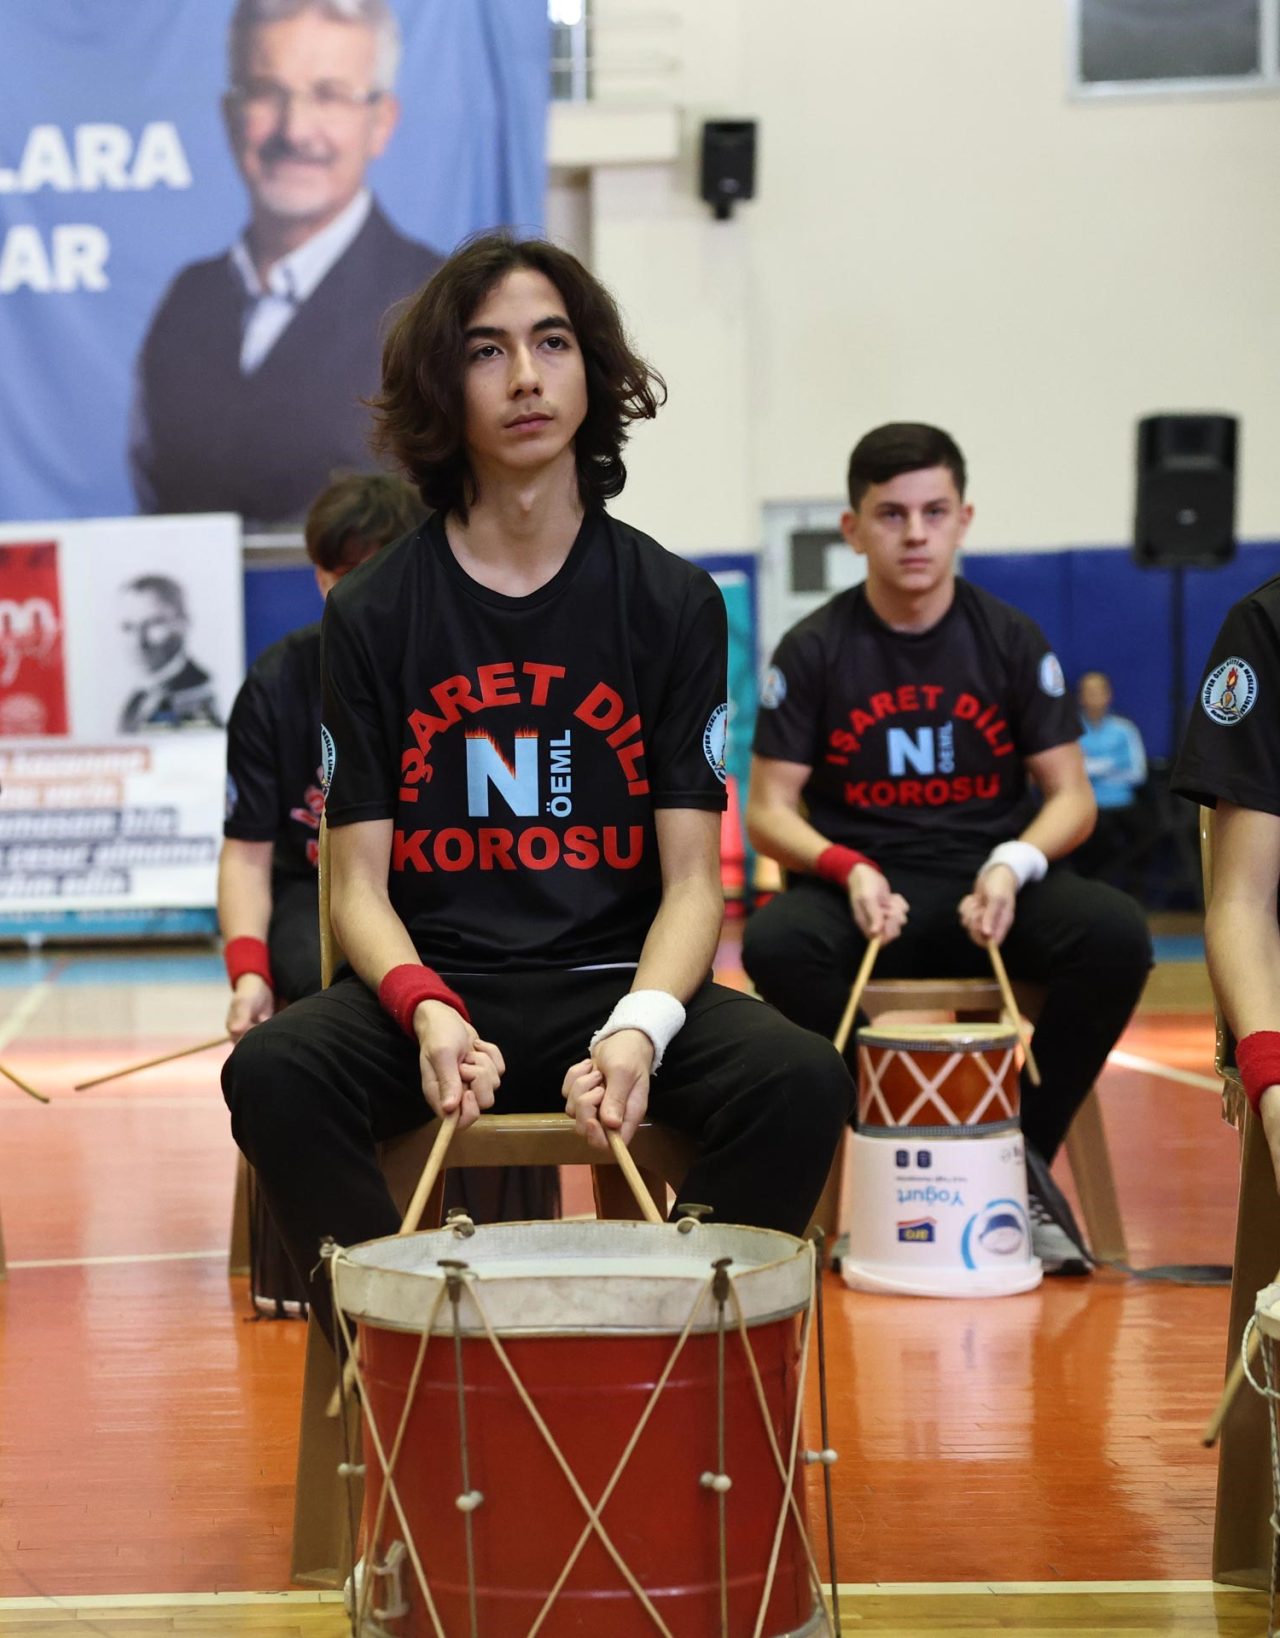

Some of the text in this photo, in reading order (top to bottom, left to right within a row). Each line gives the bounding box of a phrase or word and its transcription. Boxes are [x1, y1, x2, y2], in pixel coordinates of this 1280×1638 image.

[464, 728, 572, 818] N ÖEML
[887, 726, 935, 776] N
[844, 773, 1001, 808] KOROSU
[392, 825, 644, 873] KOROSU
